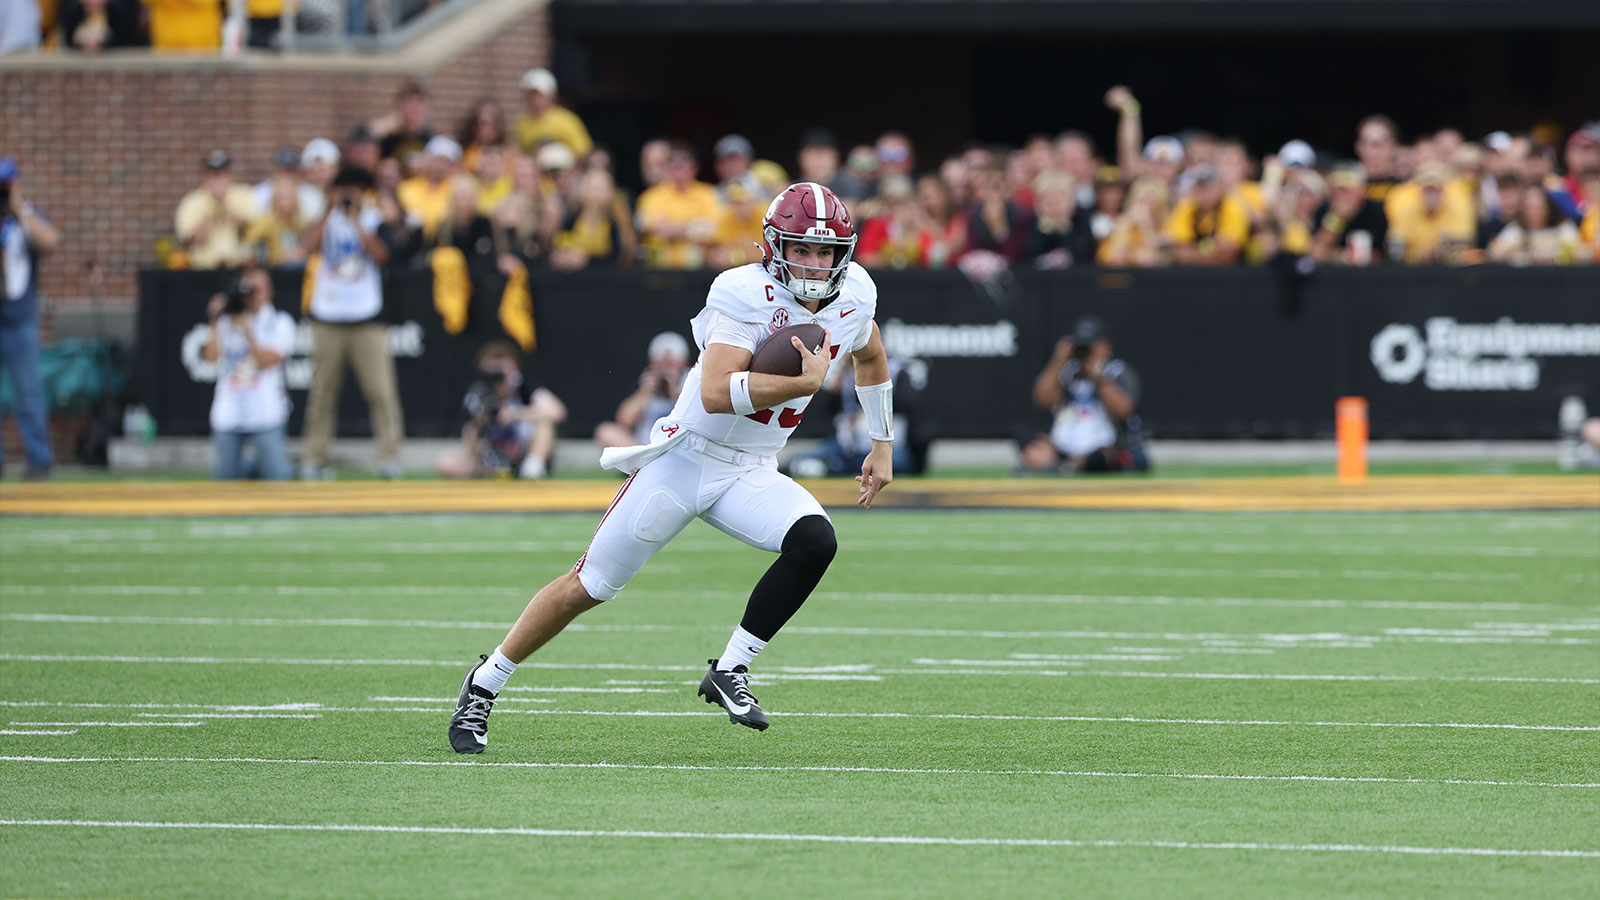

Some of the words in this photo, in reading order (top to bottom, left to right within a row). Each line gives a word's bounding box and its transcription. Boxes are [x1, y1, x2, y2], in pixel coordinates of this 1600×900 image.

[814, 228, 830, 236] BAMA
[765, 285, 774, 302] C
[885, 320, 1017, 359] ipment
[1424, 358, 1540, 391] Share
